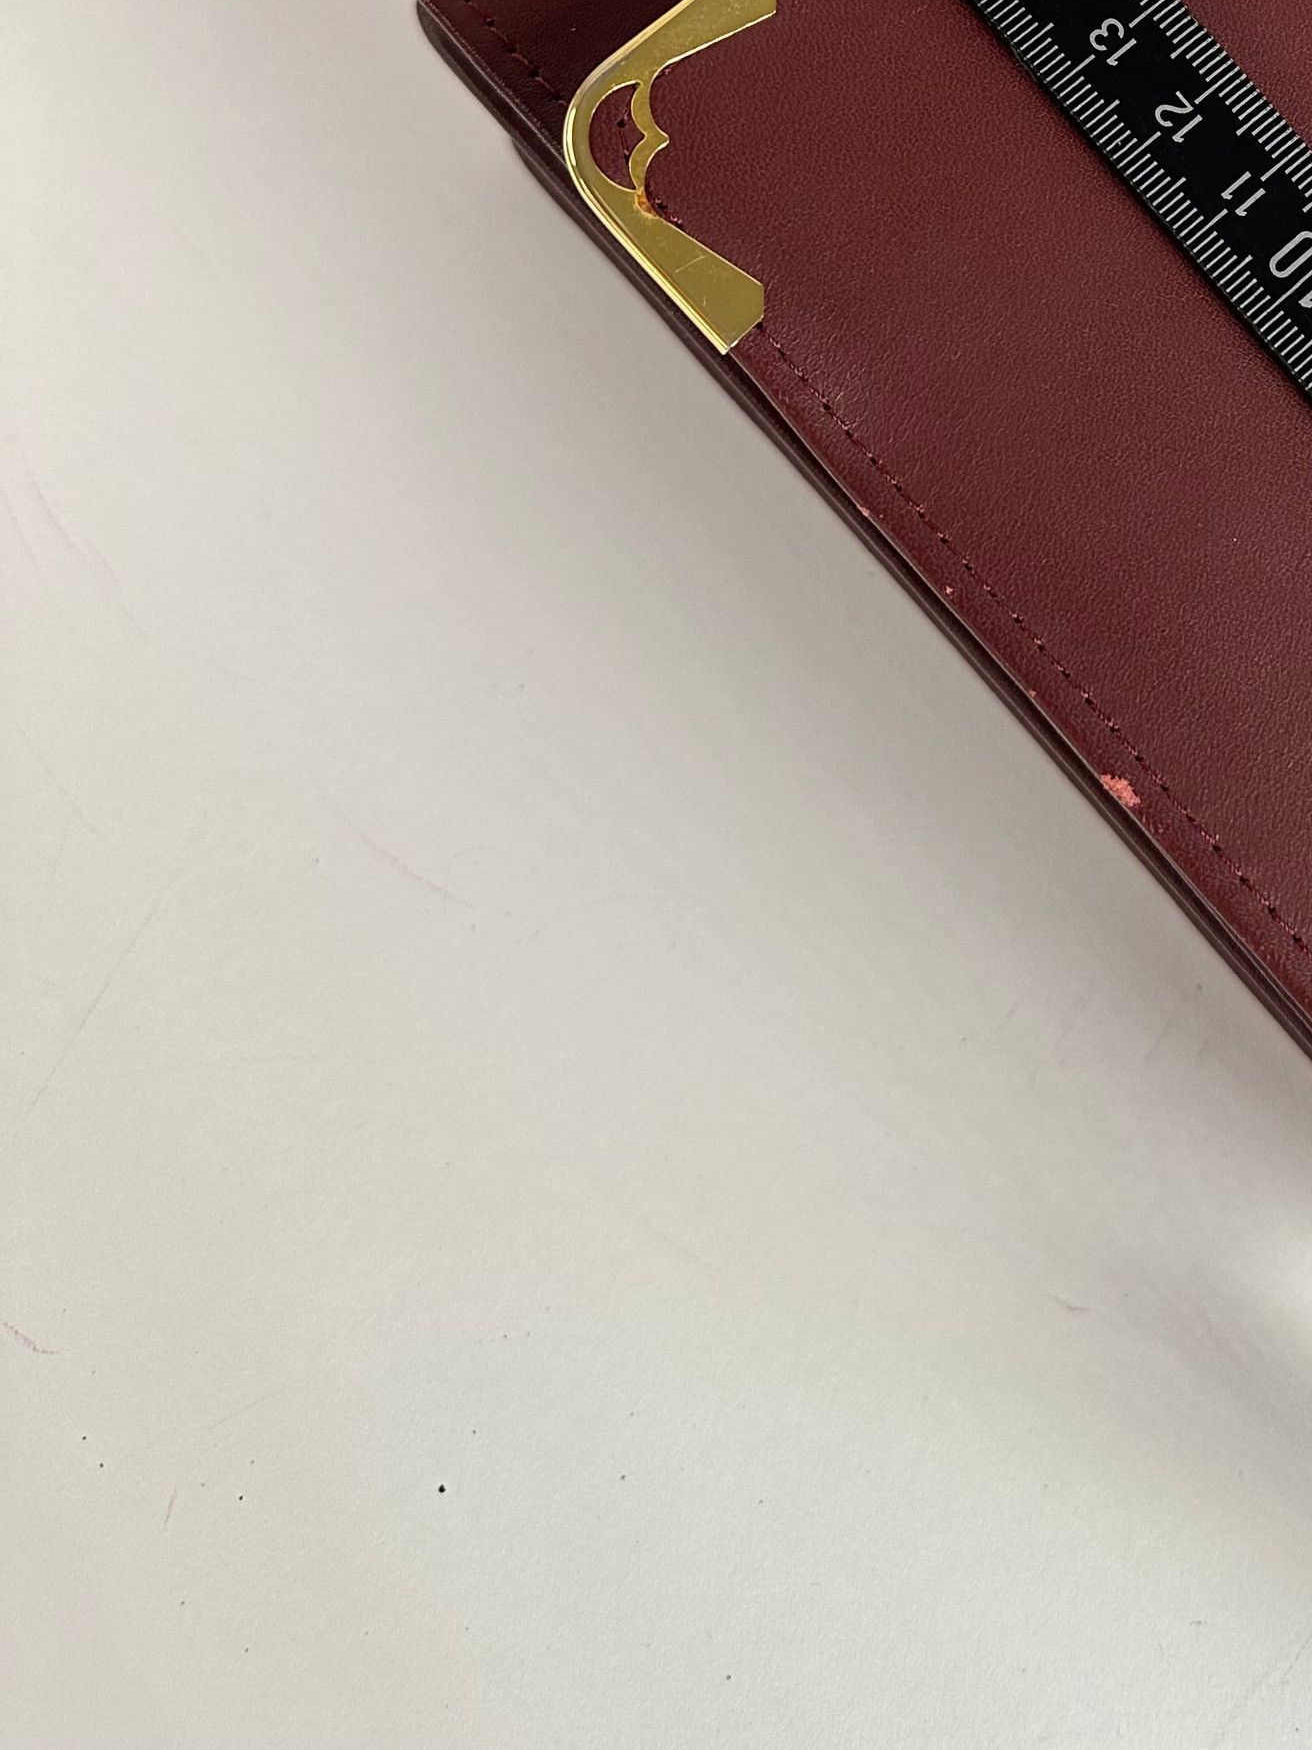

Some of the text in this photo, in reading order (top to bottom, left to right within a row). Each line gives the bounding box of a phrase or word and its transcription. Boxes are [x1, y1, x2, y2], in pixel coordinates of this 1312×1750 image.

[1089, 18, 1137, 67] 13
[1155, 91, 1203, 143] 12
[1221, 171, 1266, 217] 11
